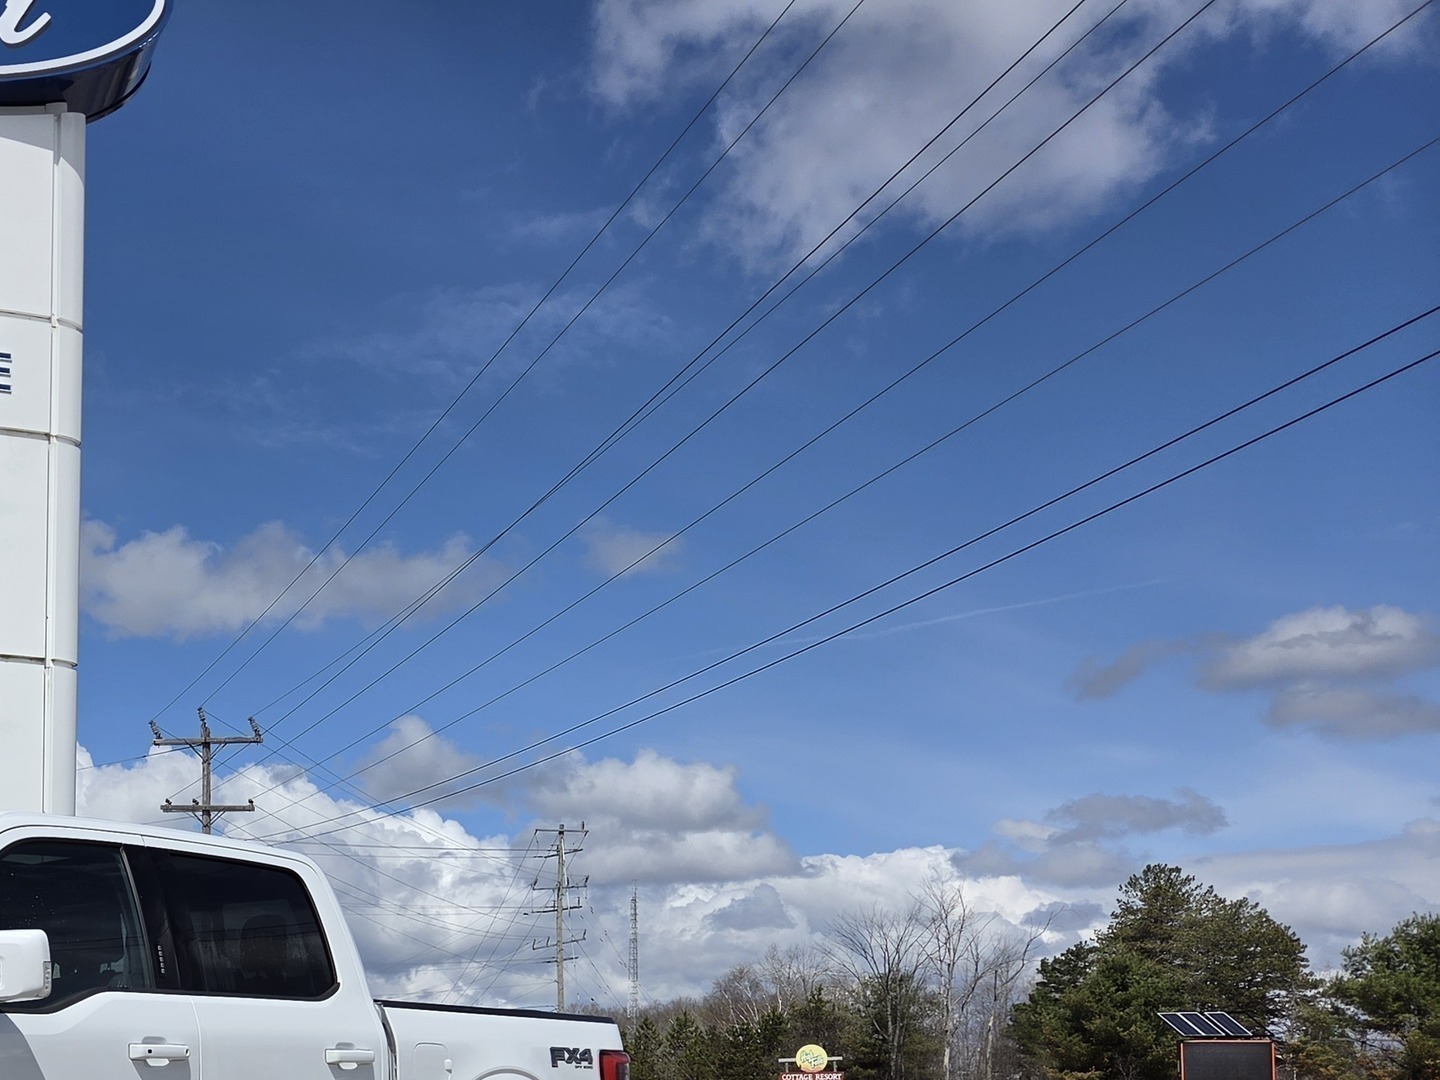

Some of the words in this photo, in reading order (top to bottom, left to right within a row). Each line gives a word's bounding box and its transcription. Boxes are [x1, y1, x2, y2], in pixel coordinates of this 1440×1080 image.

[550, 1046, 593, 1068] FX4
[781, 1073, 813, 1080] COTTAGE
[815, 1073, 842, 1080] RESORT
